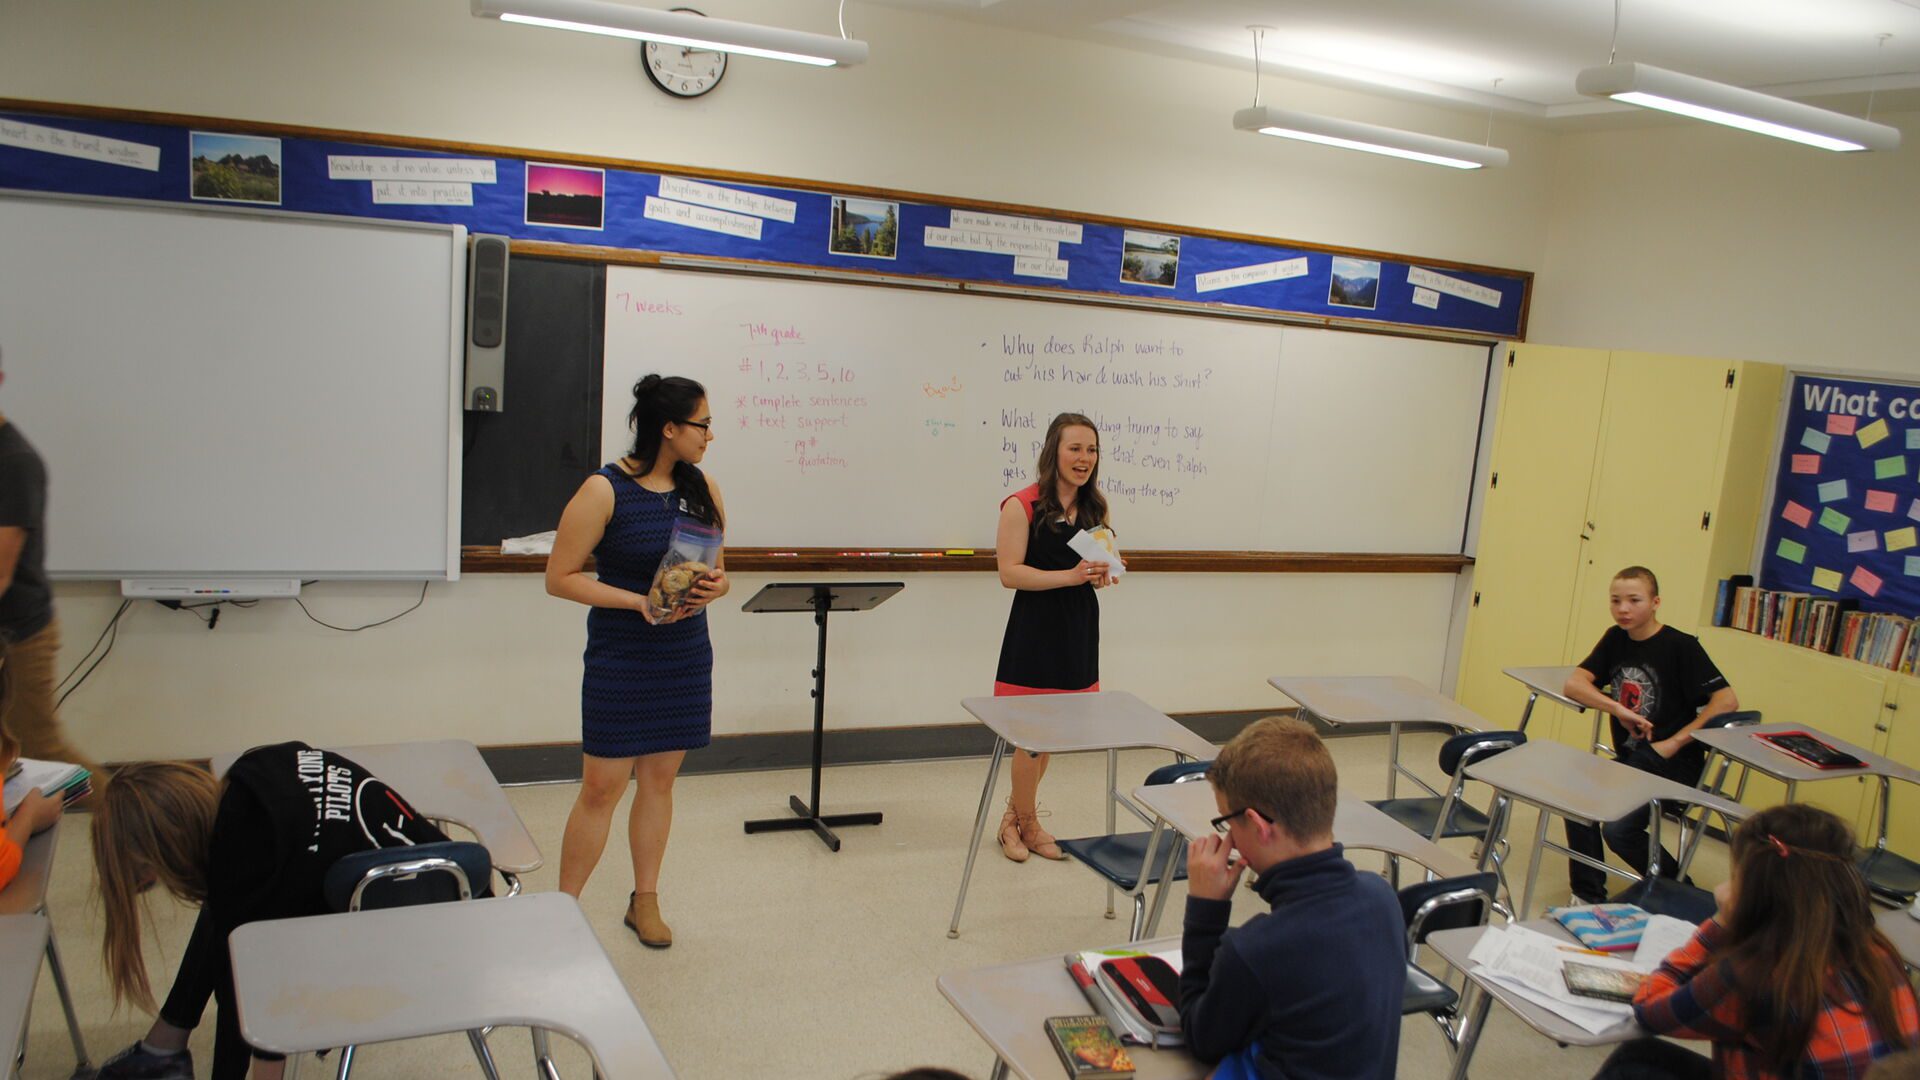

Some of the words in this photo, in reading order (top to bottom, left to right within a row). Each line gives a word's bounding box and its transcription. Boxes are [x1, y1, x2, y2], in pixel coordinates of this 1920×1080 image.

[654, 59, 662, 70] 8
[709, 68, 715, 78] 4
[666, 74, 673, 85] 7
[681, 82, 688, 91] 6
[696, 79, 703, 89] 5
[616, 292, 630, 313] 7
[1003, 334, 1035, 369] Why
[1043, 336, 1076, 355] does
[1083, 334, 1125, 363] Ralph
[1135, 339, 1166, 355] want
[1169, 341, 1184, 356] to
[840, 367, 856, 383] 10
[1003, 366, 1023, 383] cut
[1032, 365, 1055, 382] his
[1062, 365, 1093, 383] hair
[1112, 368, 1144, 387] wash
[1149, 371, 1168, 387] his
[809, 394, 868, 407] sentences
[1803, 383, 1879, 418] What
[756, 412, 786, 429] text
[798, 411, 849, 432] support
[1002, 408, 1037, 429] What
[1127, 416, 1160, 446] trying
[1164, 417, 1179, 439] to
[1184, 423, 1204, 450] say
[1003, 436, 1017, 463] by
[1112, 446, 1137, 466] that
[1141, 453, 1171, 471] even
[1176, 453, 1208, 480] Ralph
[1003, 467, 1027, 487] gets
[1139, 482, 1157, 497] the
[325, 765, 352, 822] PILOTS
